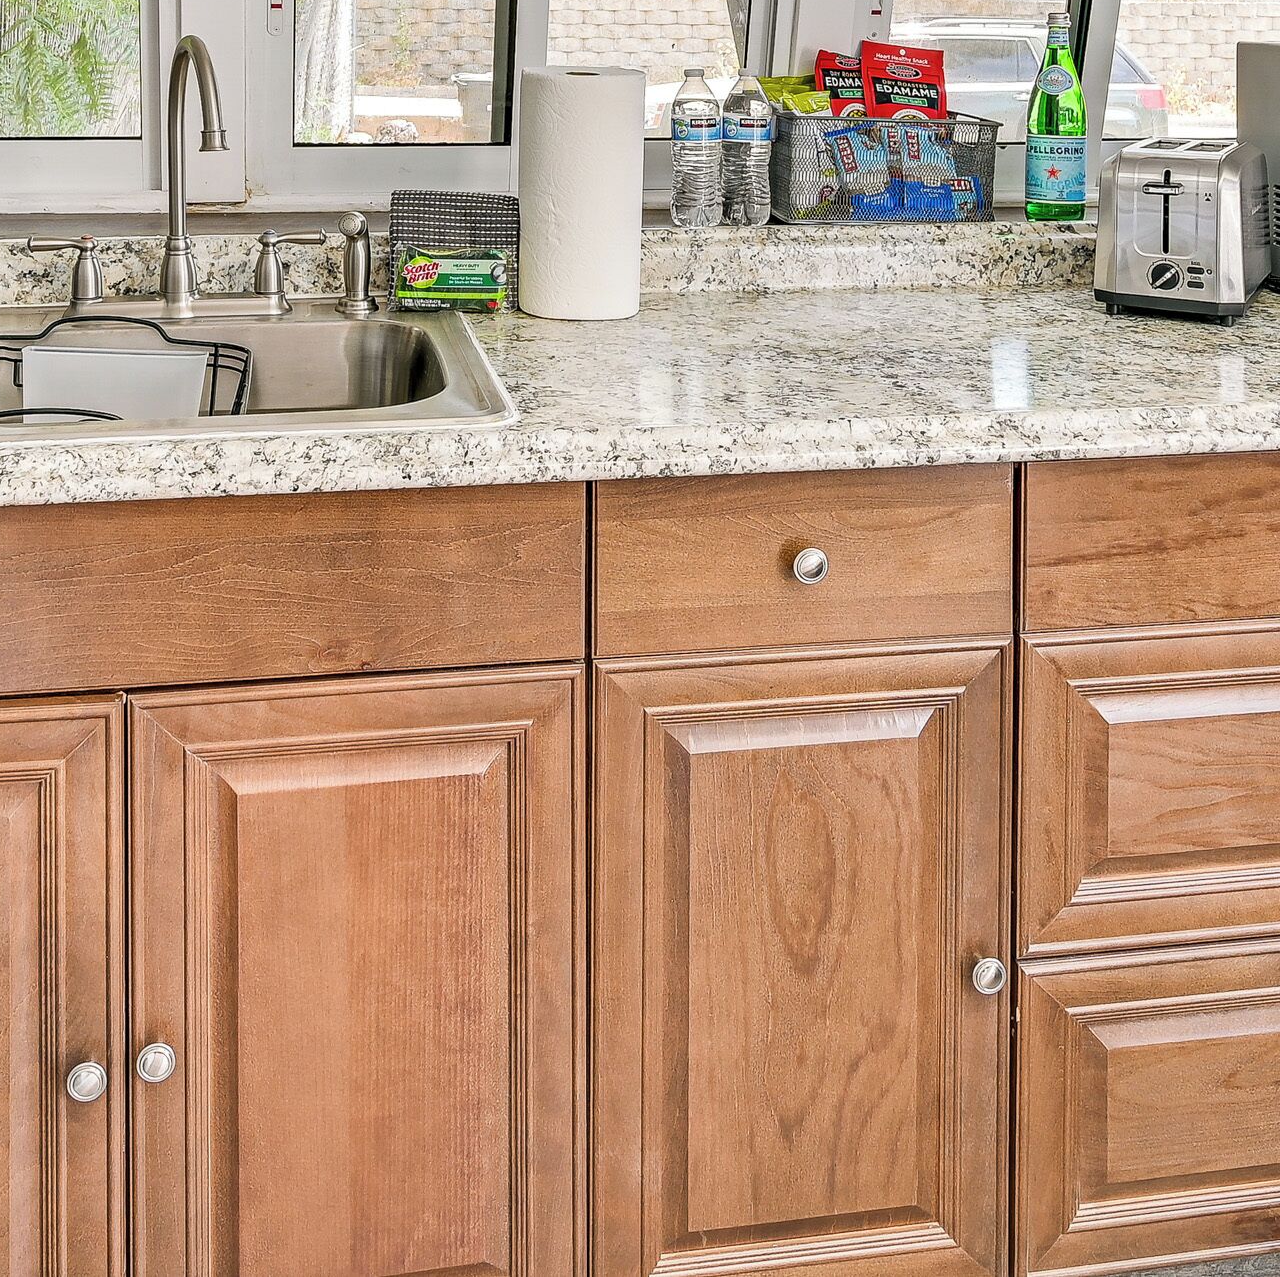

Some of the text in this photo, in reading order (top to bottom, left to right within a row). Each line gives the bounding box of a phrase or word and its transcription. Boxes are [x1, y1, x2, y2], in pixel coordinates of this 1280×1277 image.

[825, 76, 863, 87] EDAMA
[875, 83, 939, 98] EDAMAME
[408, 271, 437, 284] Brite
